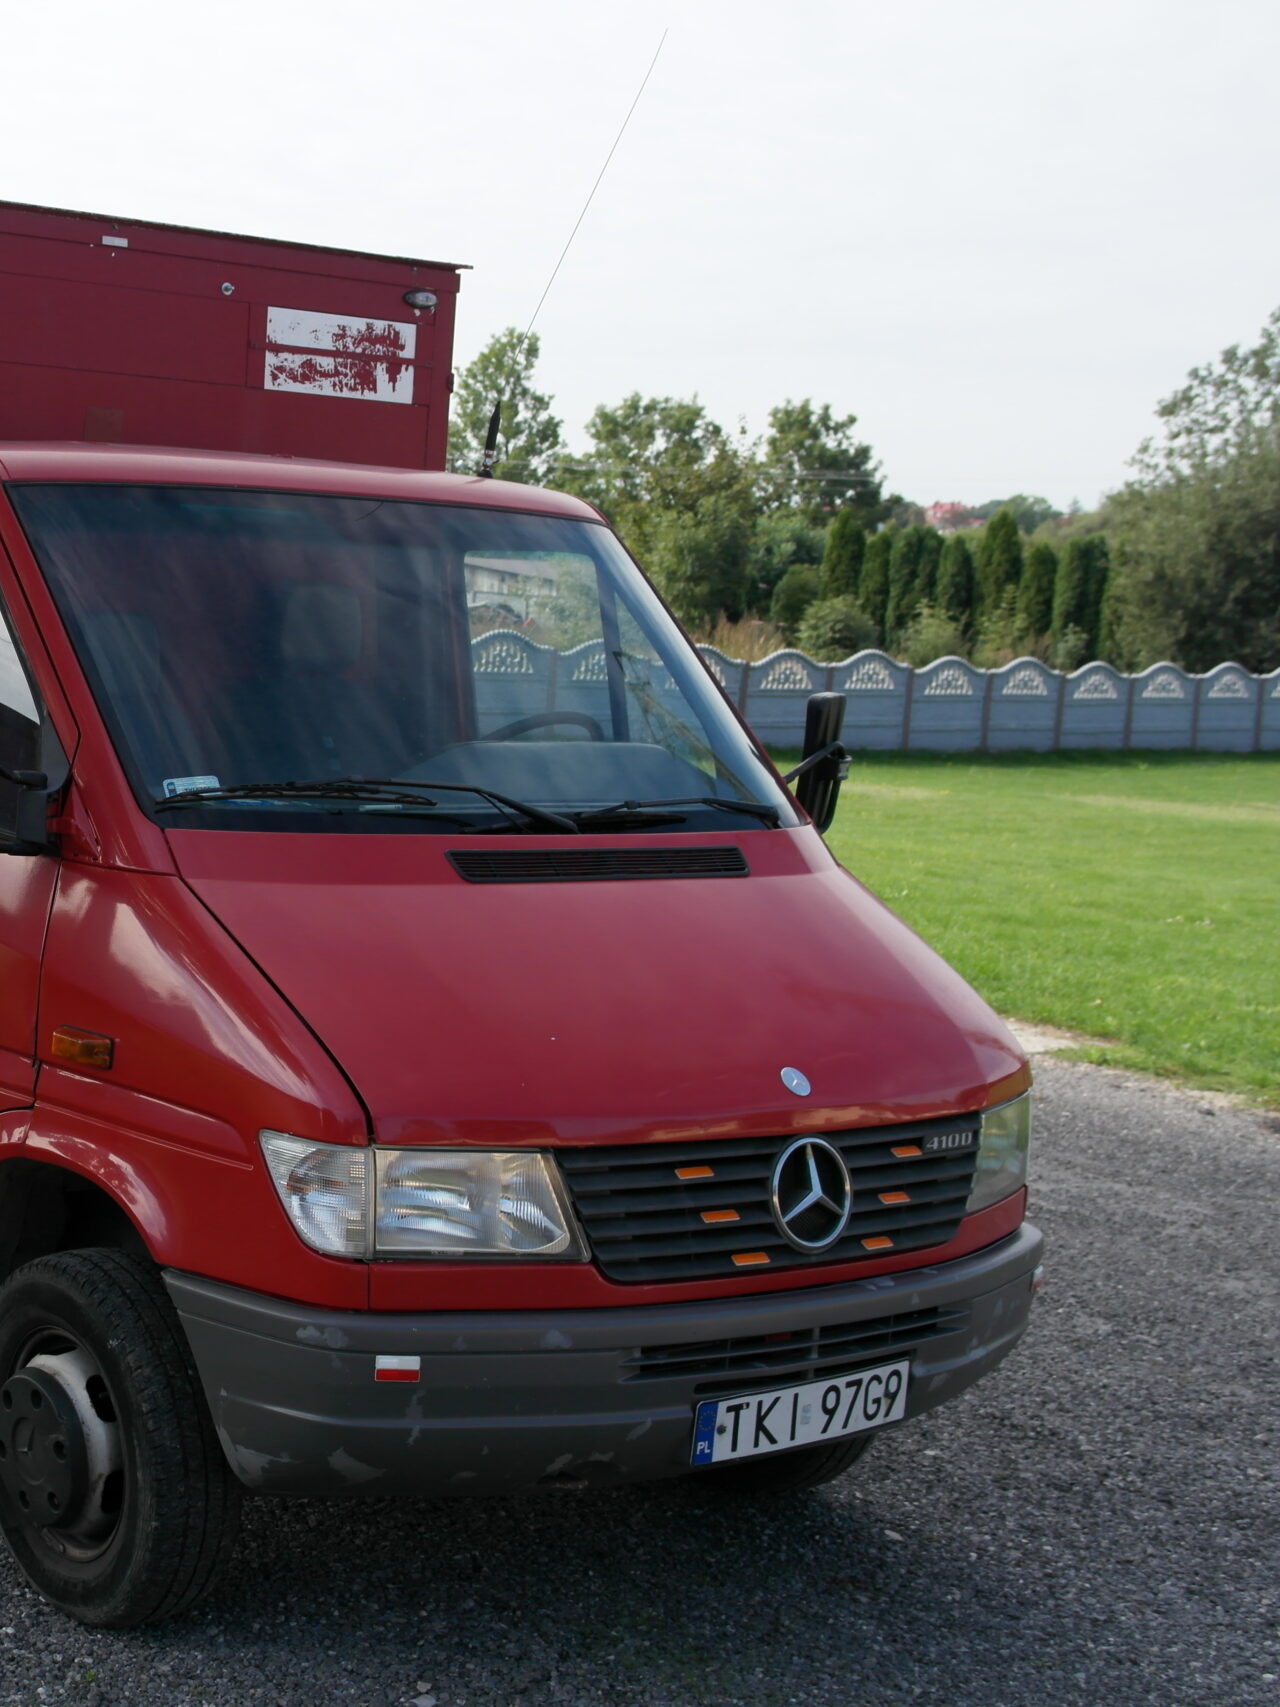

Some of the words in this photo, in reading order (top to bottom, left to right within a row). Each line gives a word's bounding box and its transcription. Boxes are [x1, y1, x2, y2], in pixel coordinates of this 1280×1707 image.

[726, 1393, 799, 1452] TKI
[821, 1369, 902, 1434] 97G9
[696, 1442, 711, 1455] PL
